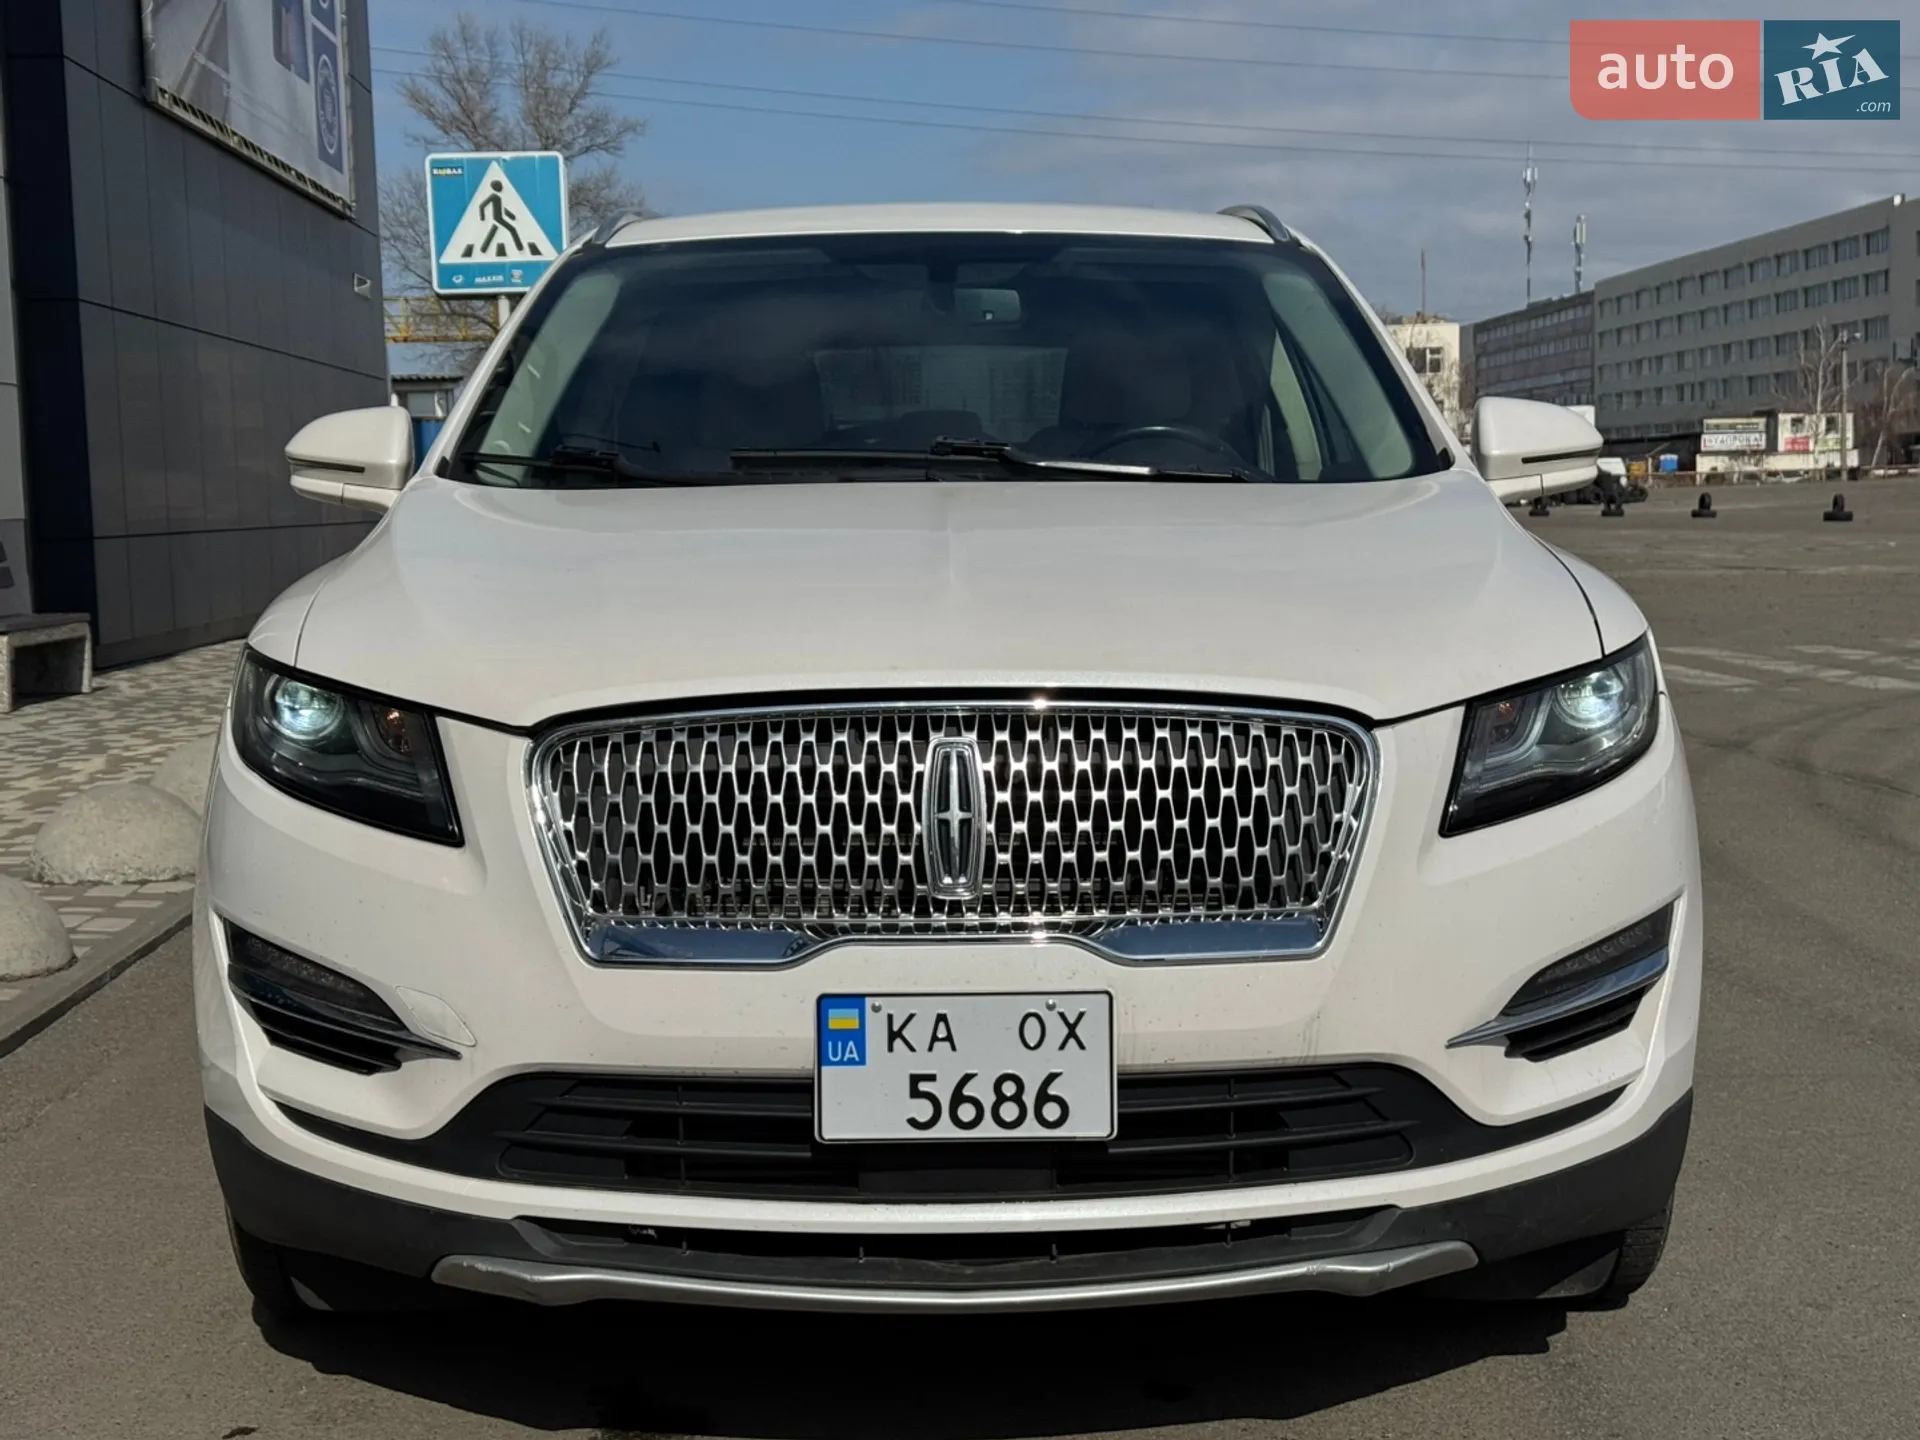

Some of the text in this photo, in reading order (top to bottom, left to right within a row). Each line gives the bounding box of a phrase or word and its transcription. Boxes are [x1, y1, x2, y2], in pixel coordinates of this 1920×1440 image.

[828, 1041, 860, 1062] UA
[886, 1012, 957, 1053] KA
[906, 1071, 1070, 1130] 5686
